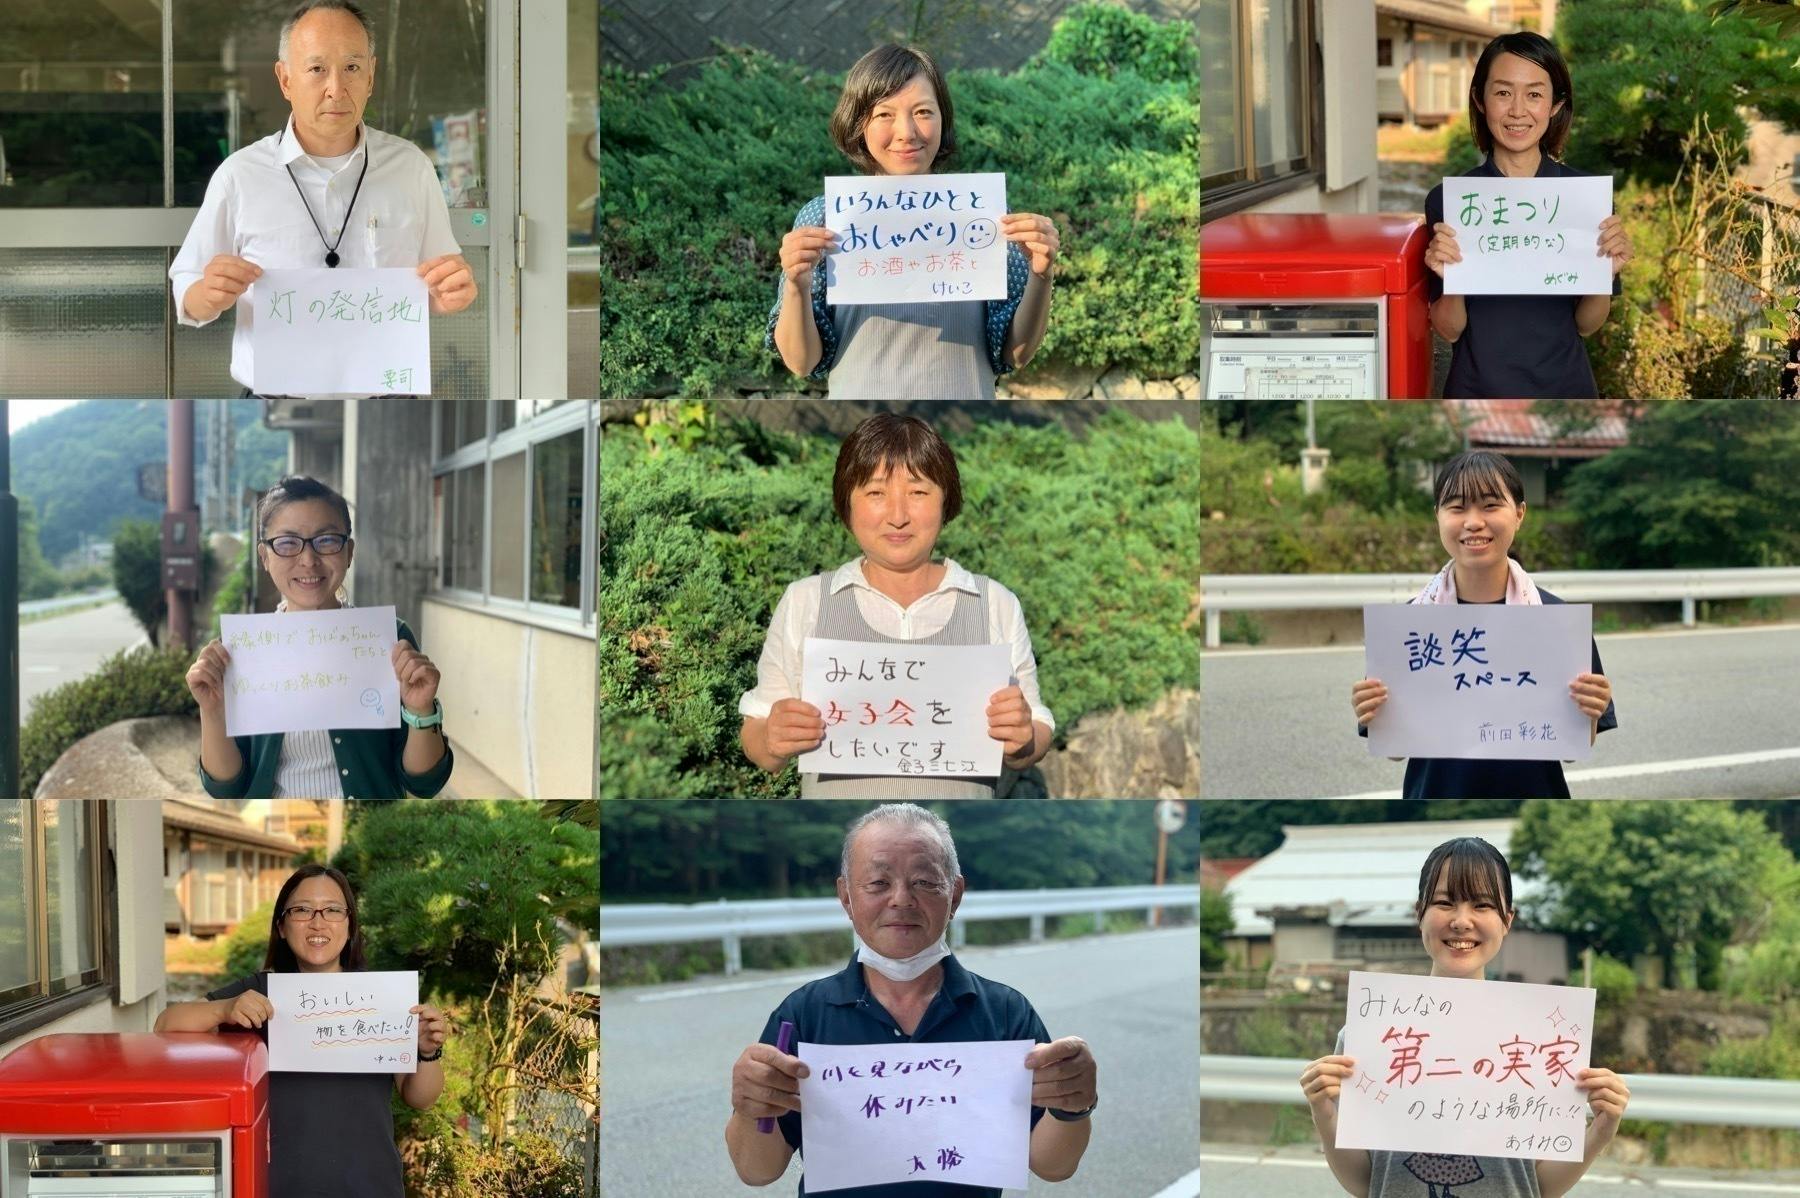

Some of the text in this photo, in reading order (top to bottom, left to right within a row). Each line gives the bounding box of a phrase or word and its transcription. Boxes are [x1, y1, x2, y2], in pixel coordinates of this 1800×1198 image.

[835, 190, 986, 214] いろんなひとと
[1460, 192, 1560, 226] おまつり
[841, 222, 957, 253] おしゃべり
[857, 251, 978, 277] お酒やお茶と
[932, 281, 973, 296] けいこ
[1543, 271, 1579, 286] めぐみ
[268, 287, 422, 324] 灯の発信地
[1404, 627, 1489, 672] 談笑
[825, 657, 926, 683] みんなで
[1453, 671, 1537, 691] スペース
[826, 699, 953, 727] 女子会を
[1478, 721, 1558, 743] 前田彩花
[829, 738, 949, 761] したいです
[298, 990, 375, 1009] おいしい
[1358, 987, 1454, 1018] みんなの
[822, 1058, 963, 1082] 川を見ながら
[1380, 1026, 1582, 1090] 第二の実家
[860, 1094, 958, 1119] 休みたい
[1505, 1134, 1553, 1151] あすみ
